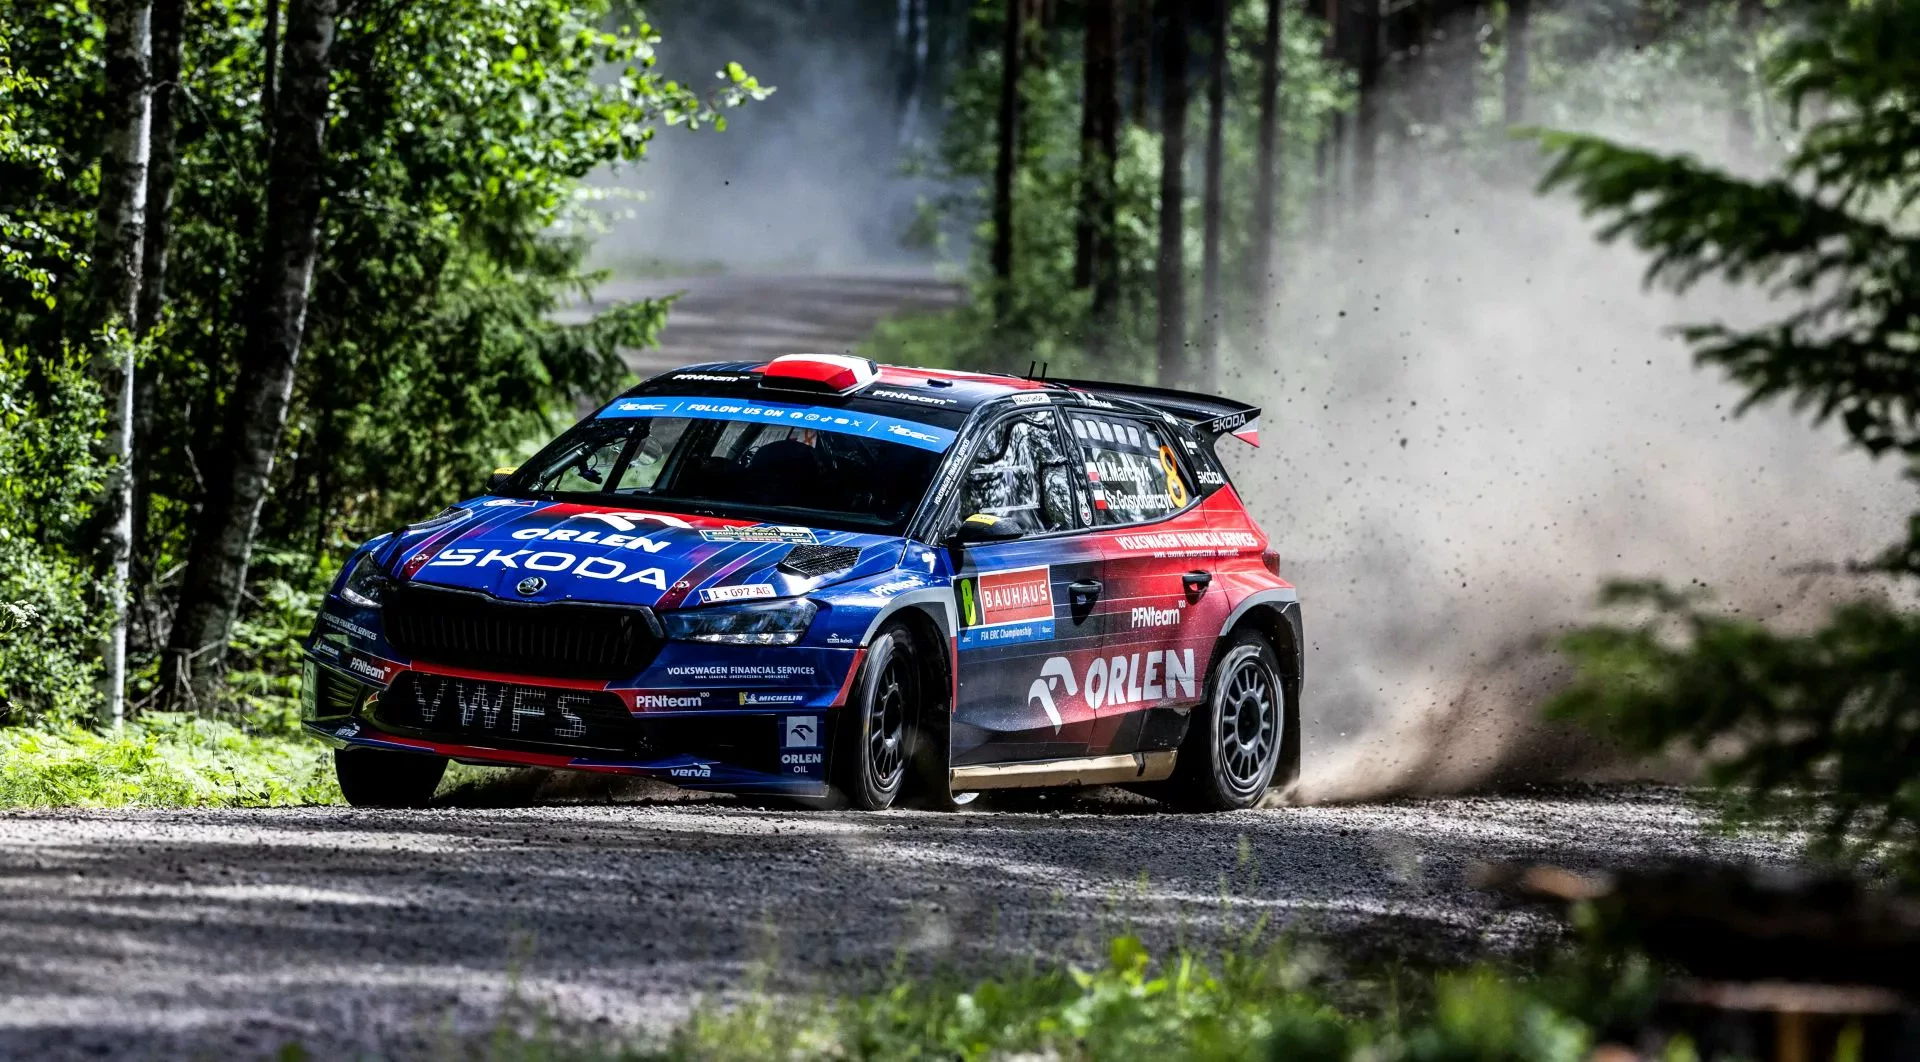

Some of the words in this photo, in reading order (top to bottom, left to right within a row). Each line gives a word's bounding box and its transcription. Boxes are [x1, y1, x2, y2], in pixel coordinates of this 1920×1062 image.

[687, 403, 742, 413] FOLLOW
[742, 407, 762, 415] US
[764, 409, 784, 417] ON
[1159, 445, 1187, 508] 8
[511, 528, 671, 553] ORLEN
[1115, 533, 1181, 550] VOLKSWAGEN
[1179, 532, 1222, 548] FINANCIAL
[1220, 531, 1258, 547] SERVICES
[961, 579, 977, 626] 8
[984, 581, 1049, 608] BAUHAUS
[980, 631, 989, 640] FIA
[990, 630, 1000, 640] ERC
[1000, 627, 1032, 639] Championship
[667, 666, 728, 675] VOLKSWAGEN
[730, 666, 775, 675] FINANCIAL
[777, 666, 815, 675] SERVICES
[1085, 649, 1195, 709] ORLEN
[413, 675, 591, 738] VWFS
[781, 754, 821, 764] ORLEN
[671, 767, 711, 778] verva
[793, 765, 808, 773] OIL
